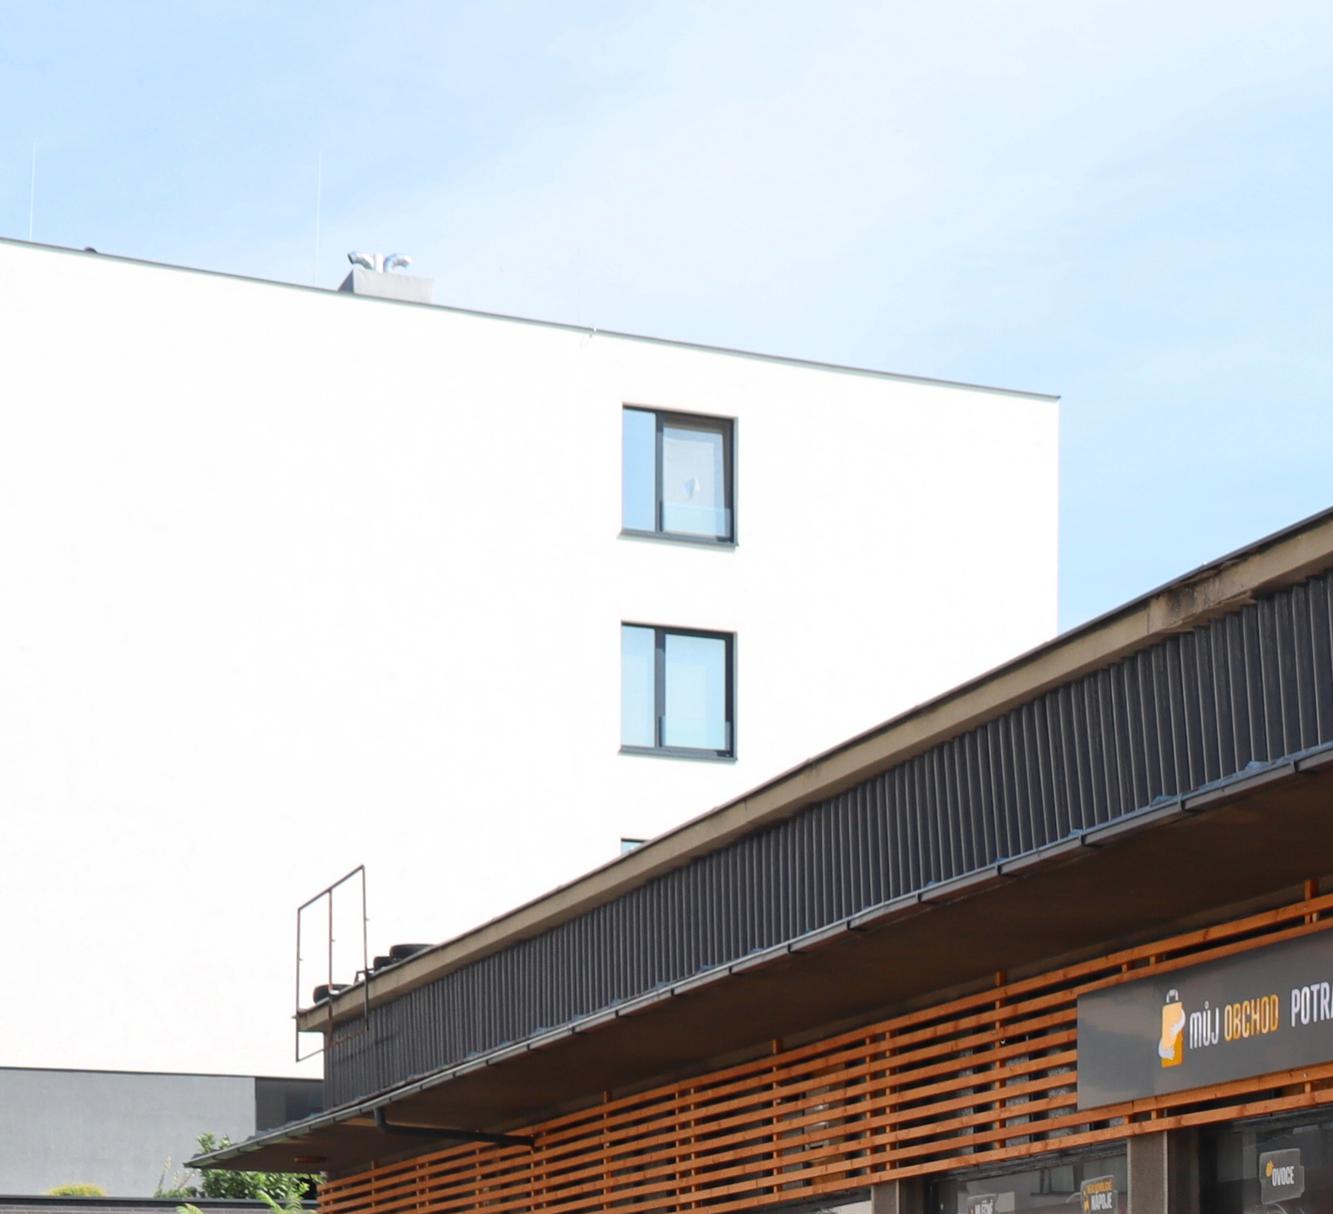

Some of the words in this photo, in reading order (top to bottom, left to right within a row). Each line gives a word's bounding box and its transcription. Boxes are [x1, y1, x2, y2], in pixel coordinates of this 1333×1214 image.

[1189, 1000, 1219, 1049] MŮJ
[1224, 994, 1279, 1041] OBCHOD
[1272, 1165, 1295, 1187] OVOCE
